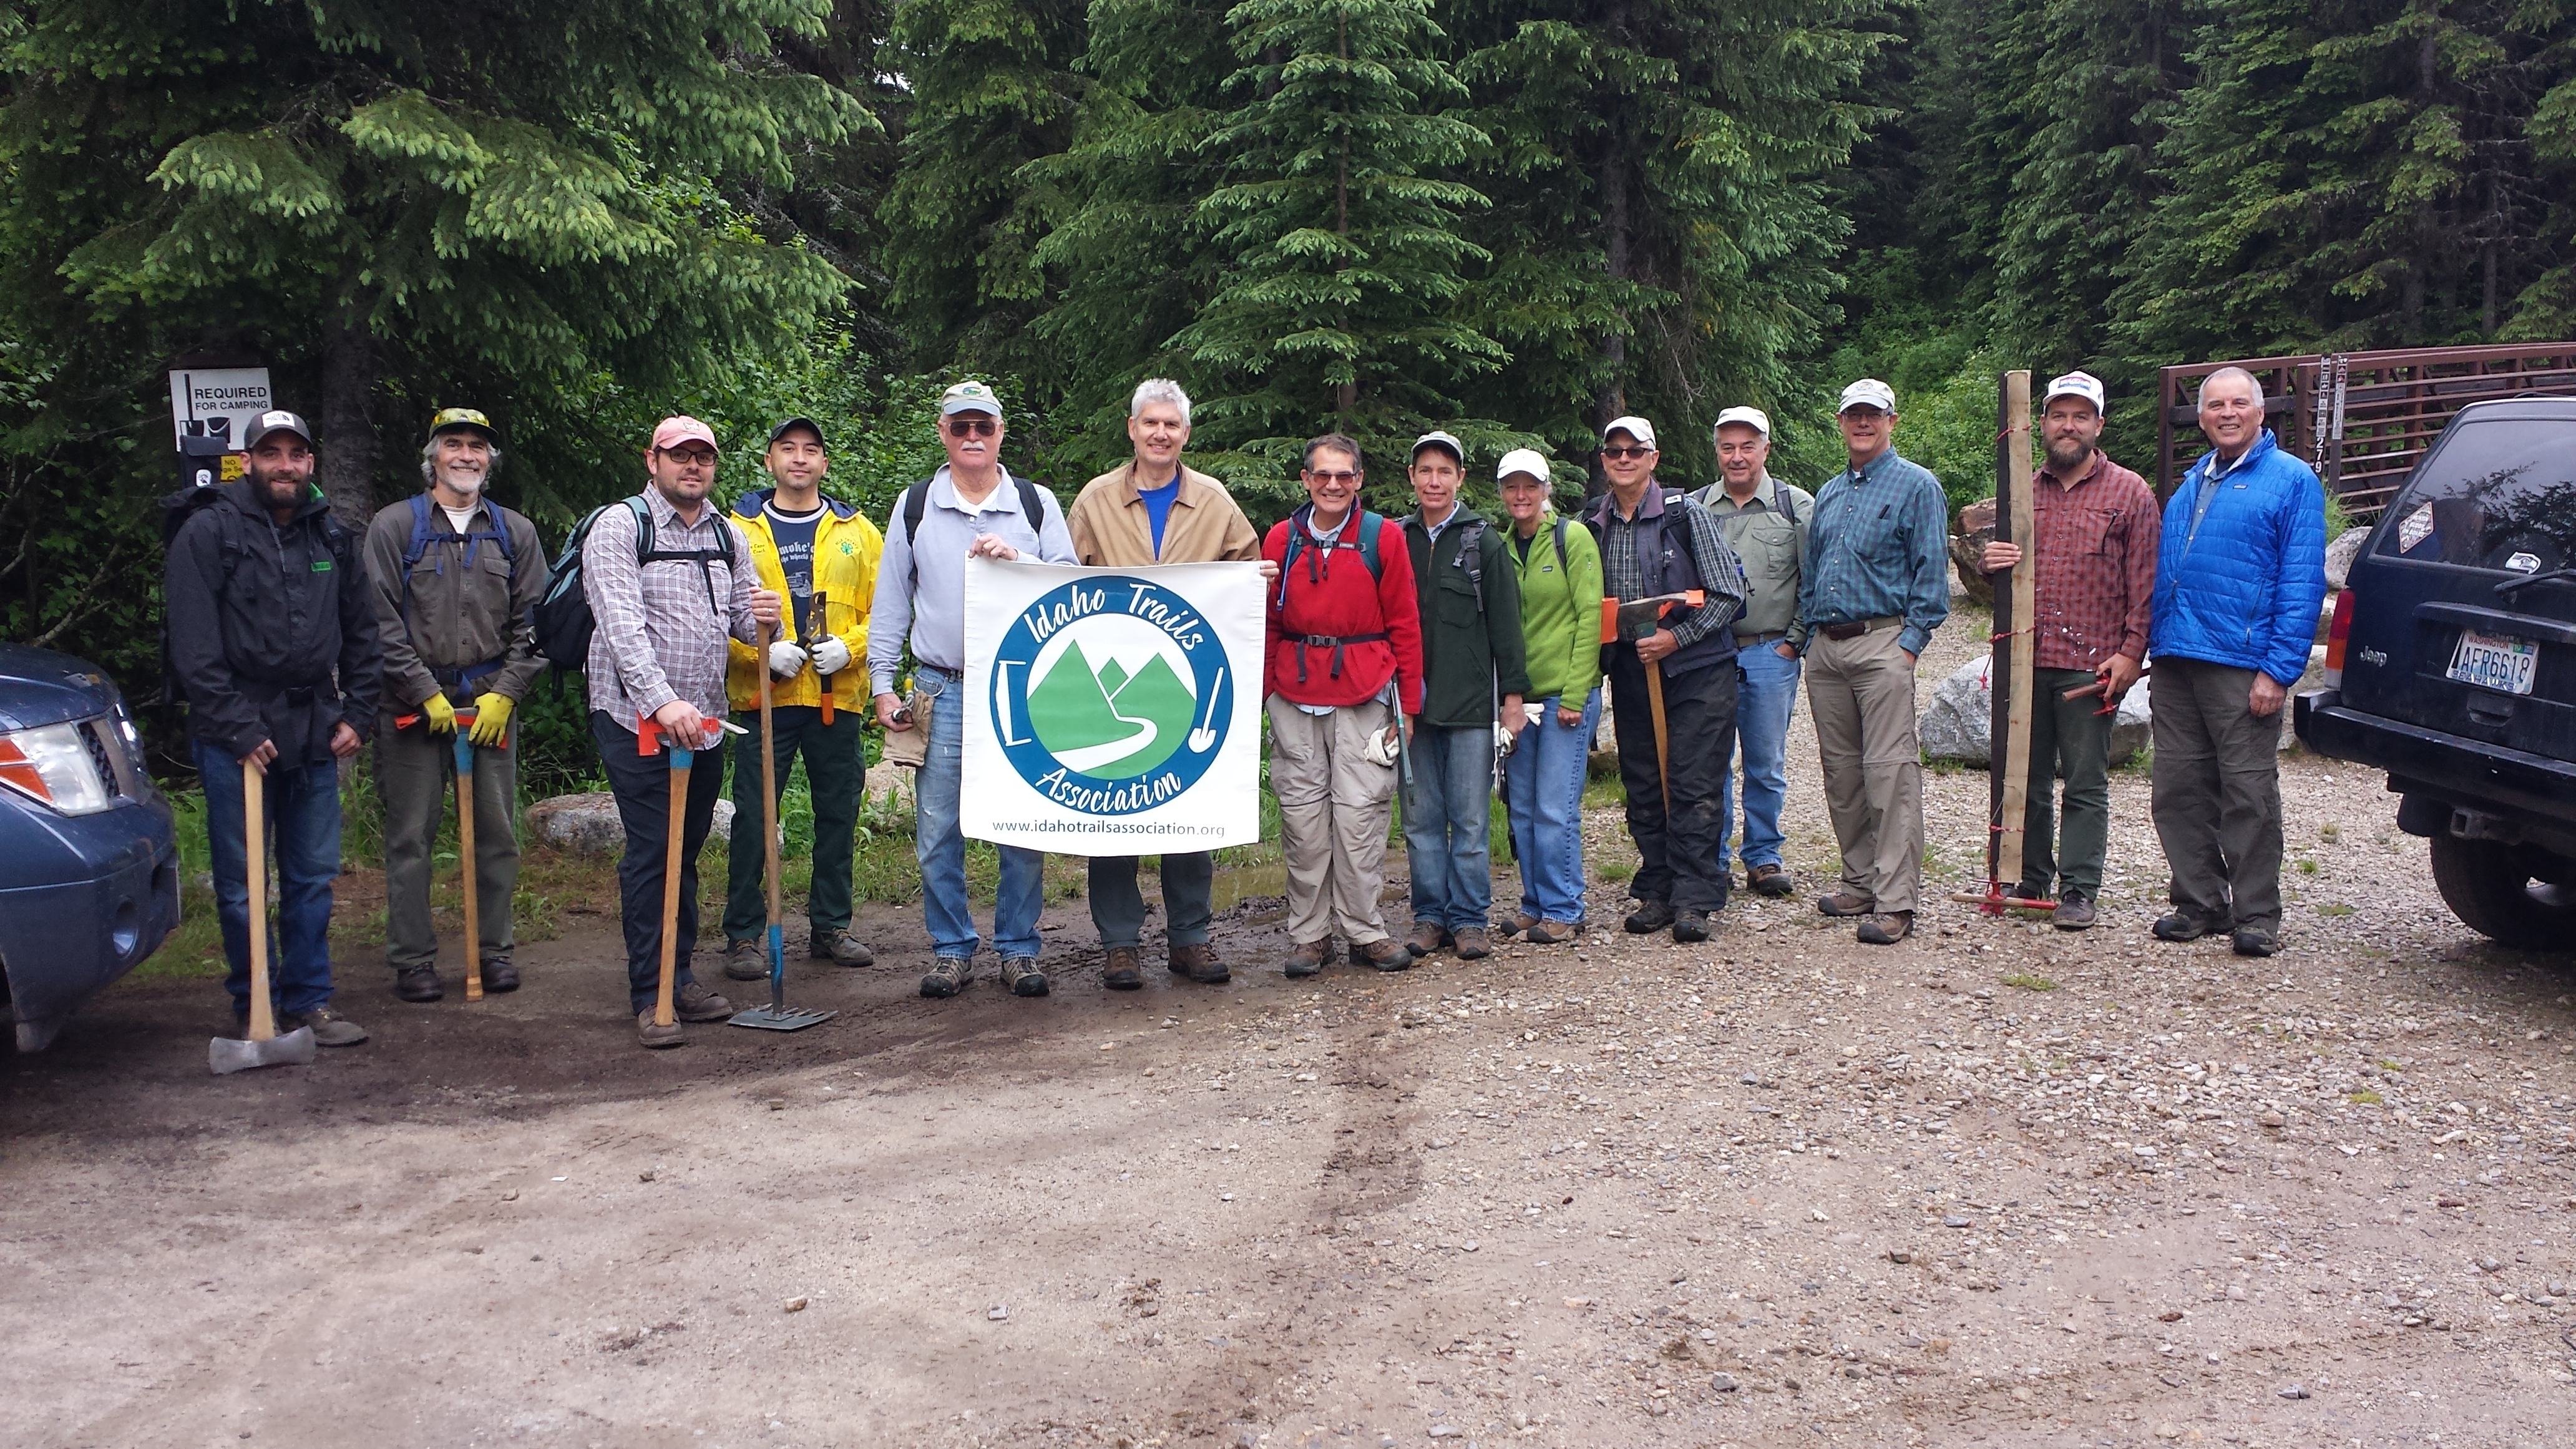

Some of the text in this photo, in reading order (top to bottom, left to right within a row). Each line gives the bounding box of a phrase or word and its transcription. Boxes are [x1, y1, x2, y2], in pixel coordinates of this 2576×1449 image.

[195, 387, 266, 398] REQUIRED
[195, 401, 268, 411] FOR CAMPING
[2315, 437, 2324, 473] 279
[1024, 582, 1204, 651] Idaho Trails
[2468, 636, 2509, 649] WASHINGTON
[2359, 645, 2387, 666] Jeep
[2461, 646, 2530, 683] AFR6618
[2452, 670, 2517, 691] SEAHAWKS
[1035, 768, 1182, 812] Association
[993, 819, 1224, 838] www.idahotrailsassociation.org
